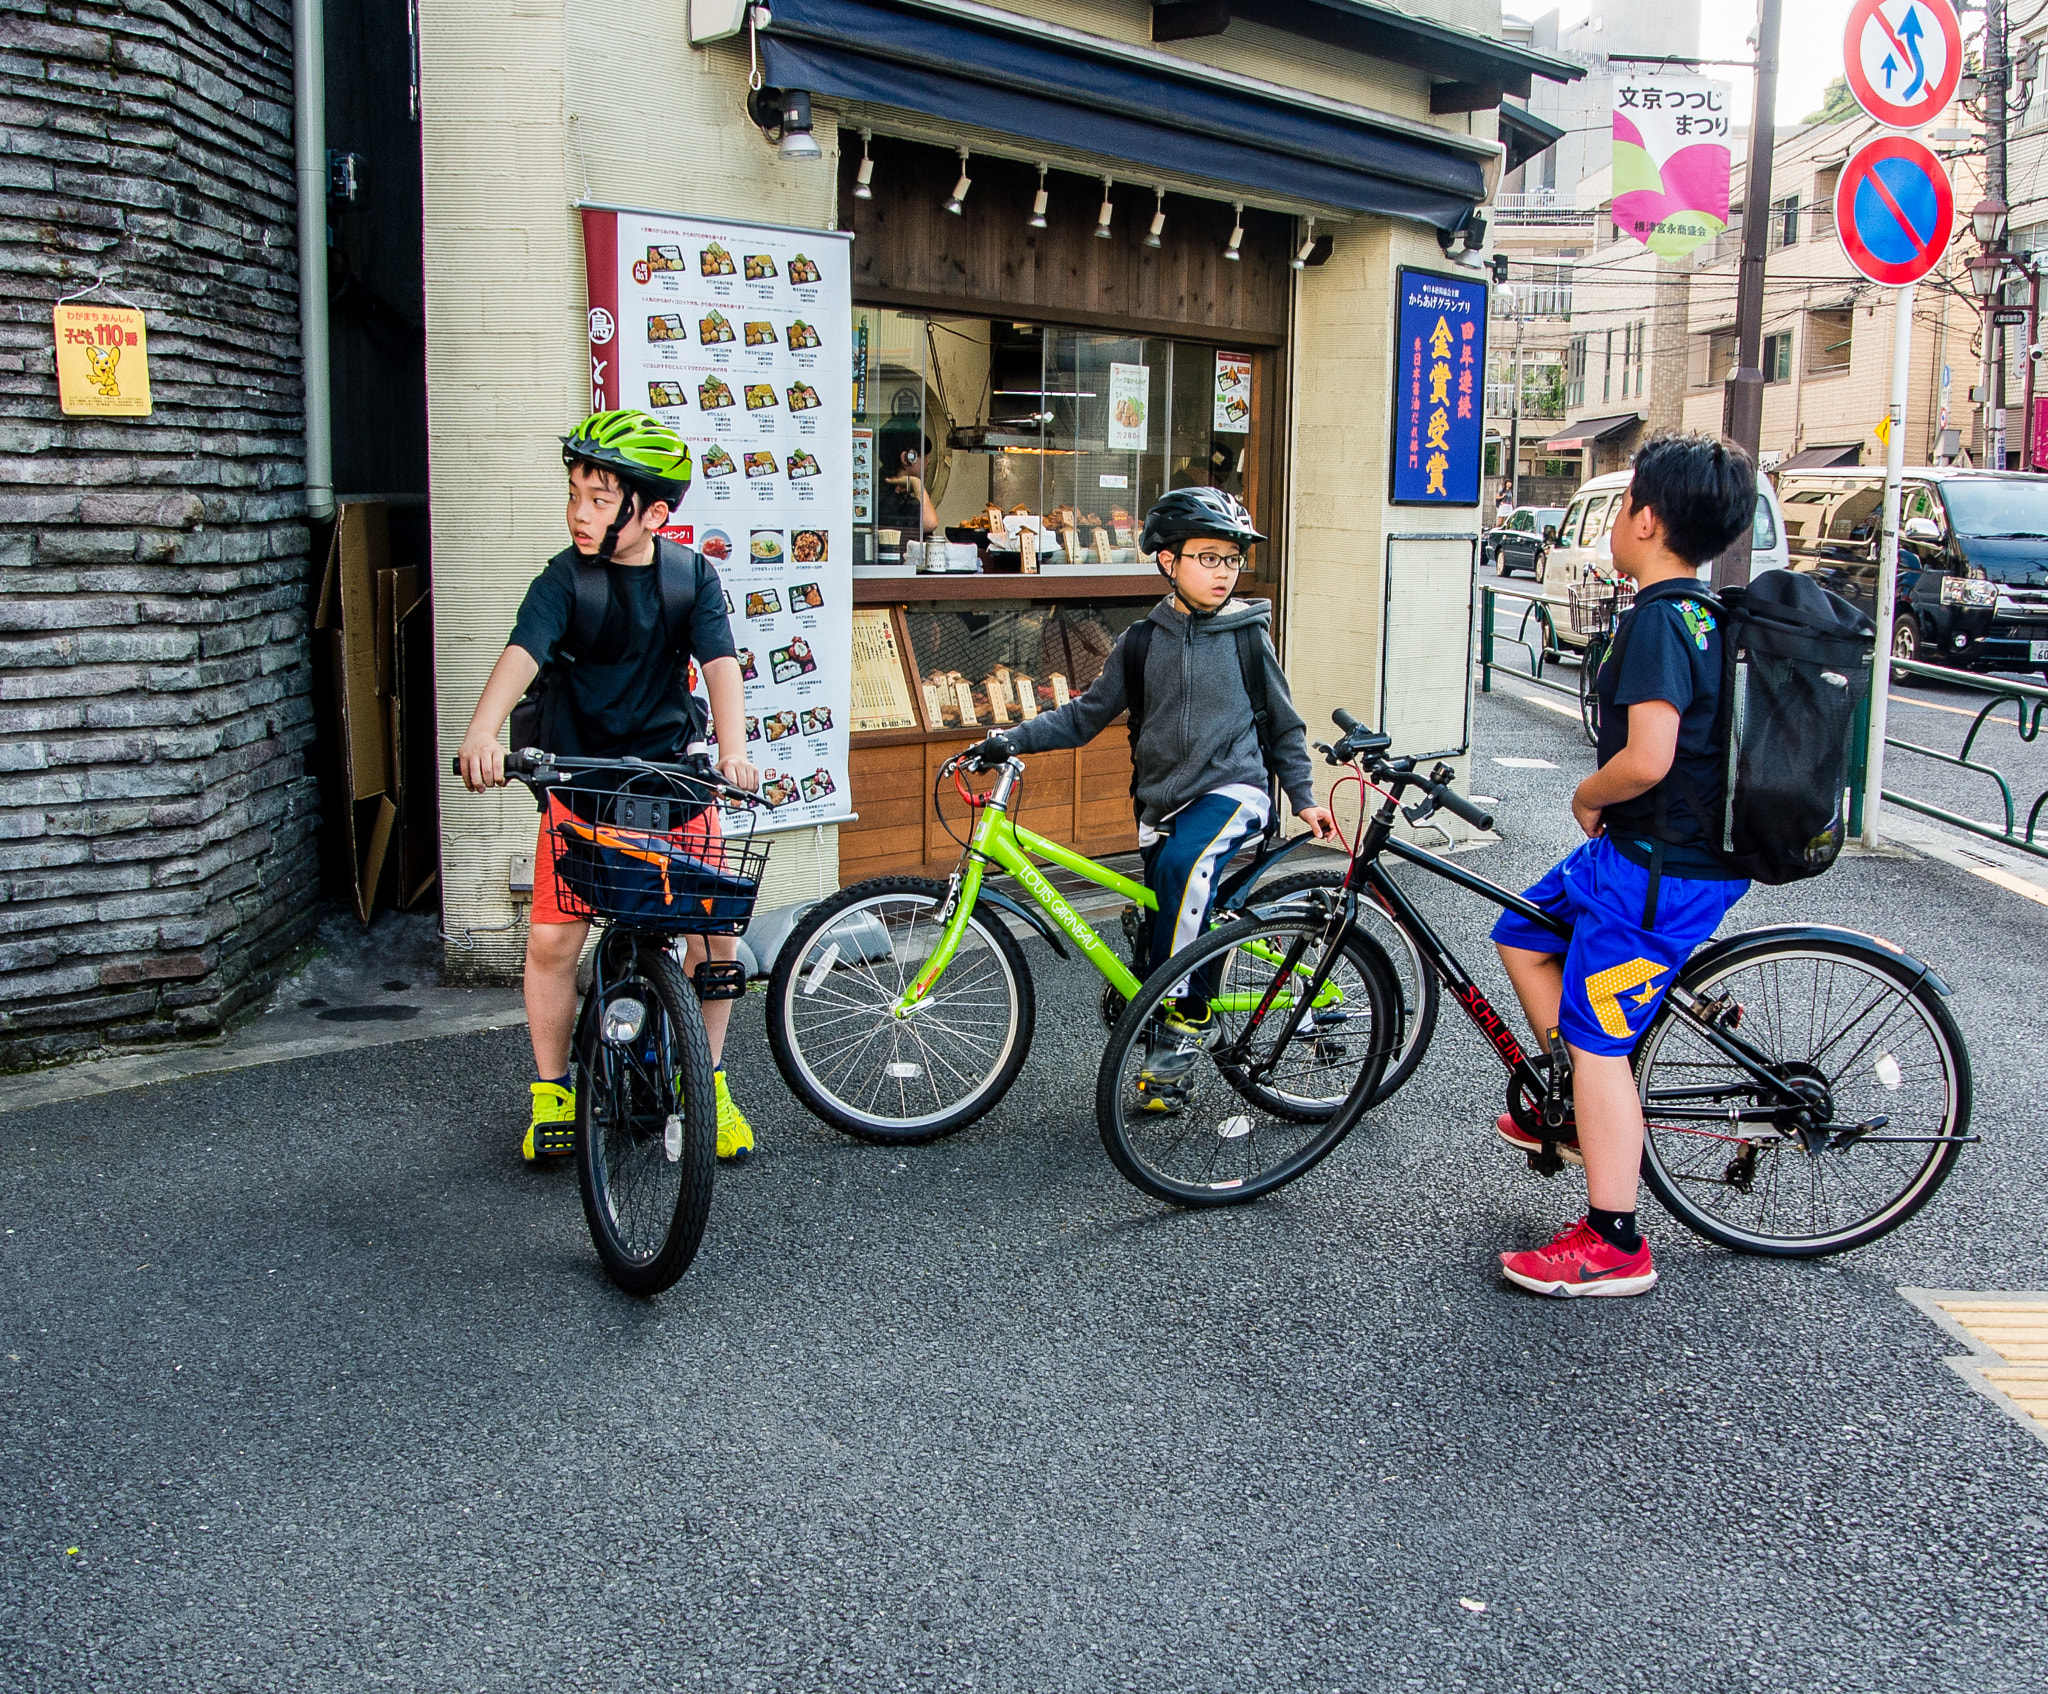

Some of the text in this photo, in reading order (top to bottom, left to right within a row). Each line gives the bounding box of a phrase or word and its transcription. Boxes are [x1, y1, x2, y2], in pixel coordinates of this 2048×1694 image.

[1618, 86, 1723, 111] 文京つつじ
[1675, 114, 1728, 137] まつり
[1634, 221, 1707, 237] 根津宮永商盛会
[1408, 293, 1470, 314] からあげグランプリ
[66, 312, 134, 323] わがまち あんしん
[591, 311, 613, 339] 鳥
[64, 323, 138, 346] 子ども110番
[1425, 315, 1453, 496] 金賞受賞
[1019, 865, 1098, 950] LOUIS GARNEAU
[1461, 985, 1526, 1065] SCHLEIN
